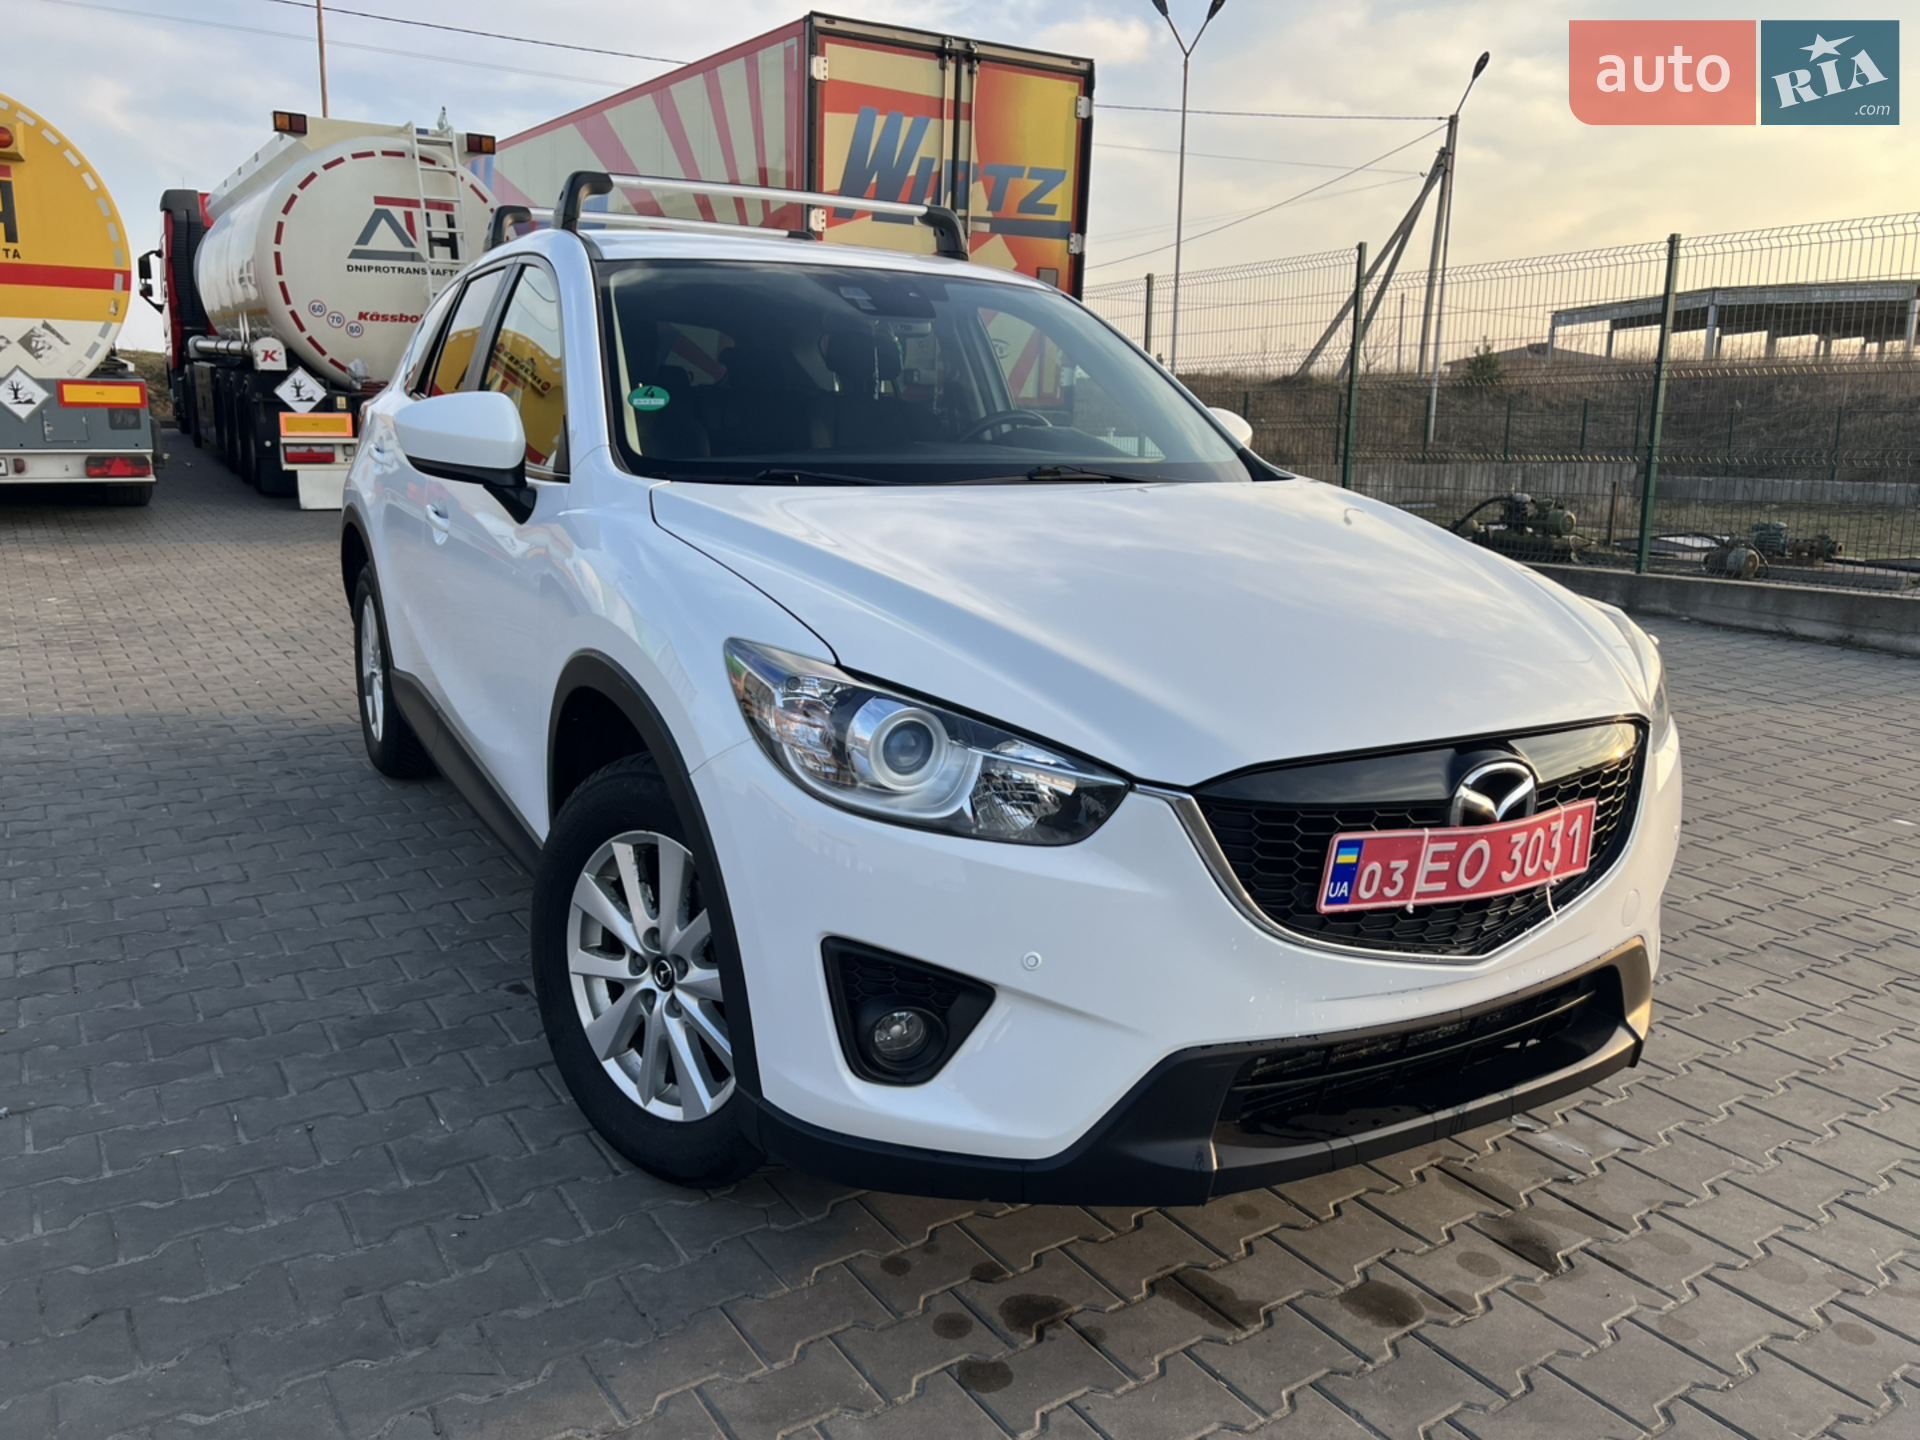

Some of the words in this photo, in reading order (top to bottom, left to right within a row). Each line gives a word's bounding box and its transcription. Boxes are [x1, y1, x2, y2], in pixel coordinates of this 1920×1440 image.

[832, 105, 1067, 225] WIRTZ
[312, 303, 323, 313] 60
[330, 314, 342, 325] 70
[357, 311, 424, 323] Kässbo
[349, 325, 361, 334] 80
[261, 349, 278, 362] K
[644, 387, 655, 398] 4
[1357, 860, 1409, 900] 03
[1416, 839, 1491, 893] EO
[1501, 815, 1585, 884] 3031
[1328, 881, 1348, 897] UA
